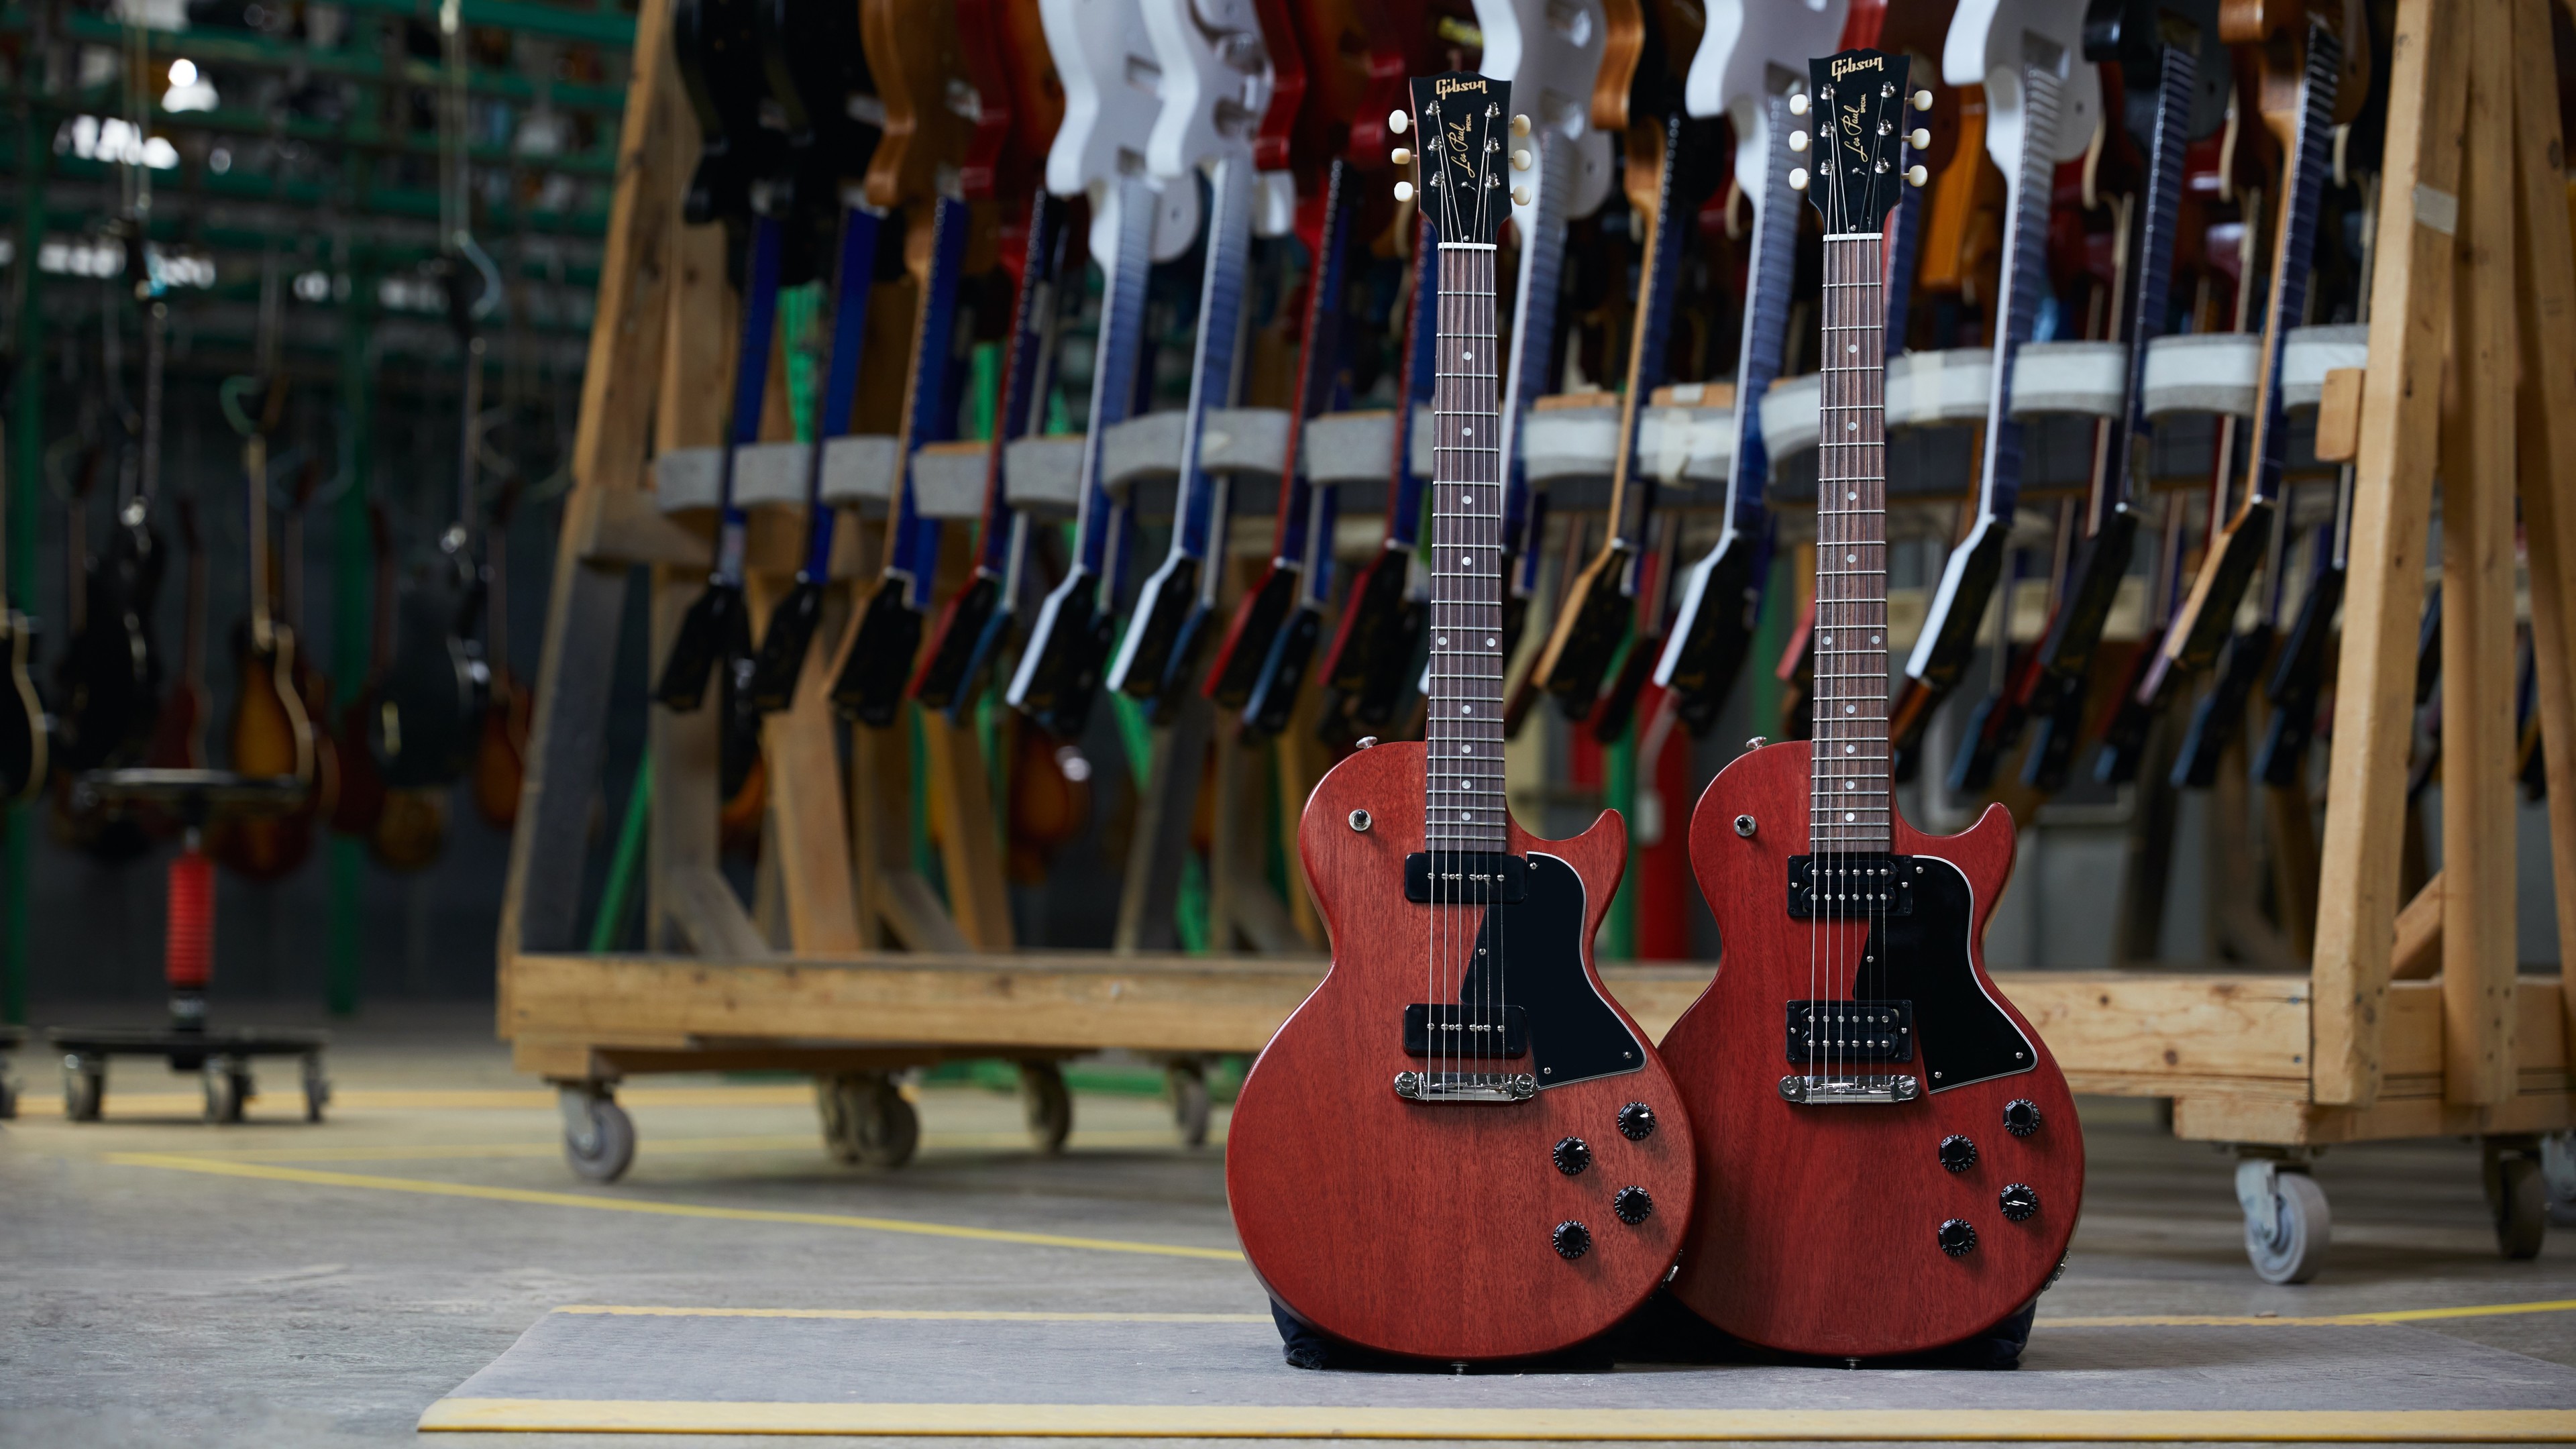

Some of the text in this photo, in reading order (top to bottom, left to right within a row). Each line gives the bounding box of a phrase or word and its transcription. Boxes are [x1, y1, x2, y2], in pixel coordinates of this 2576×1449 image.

[1436, 78, 1488, 100] Gibson
[1831, 56, 1884, 82] Gibson
[1446, 122, 1475, 178] Les Paul
[1840, 105, 1868, 162] Les Paul
